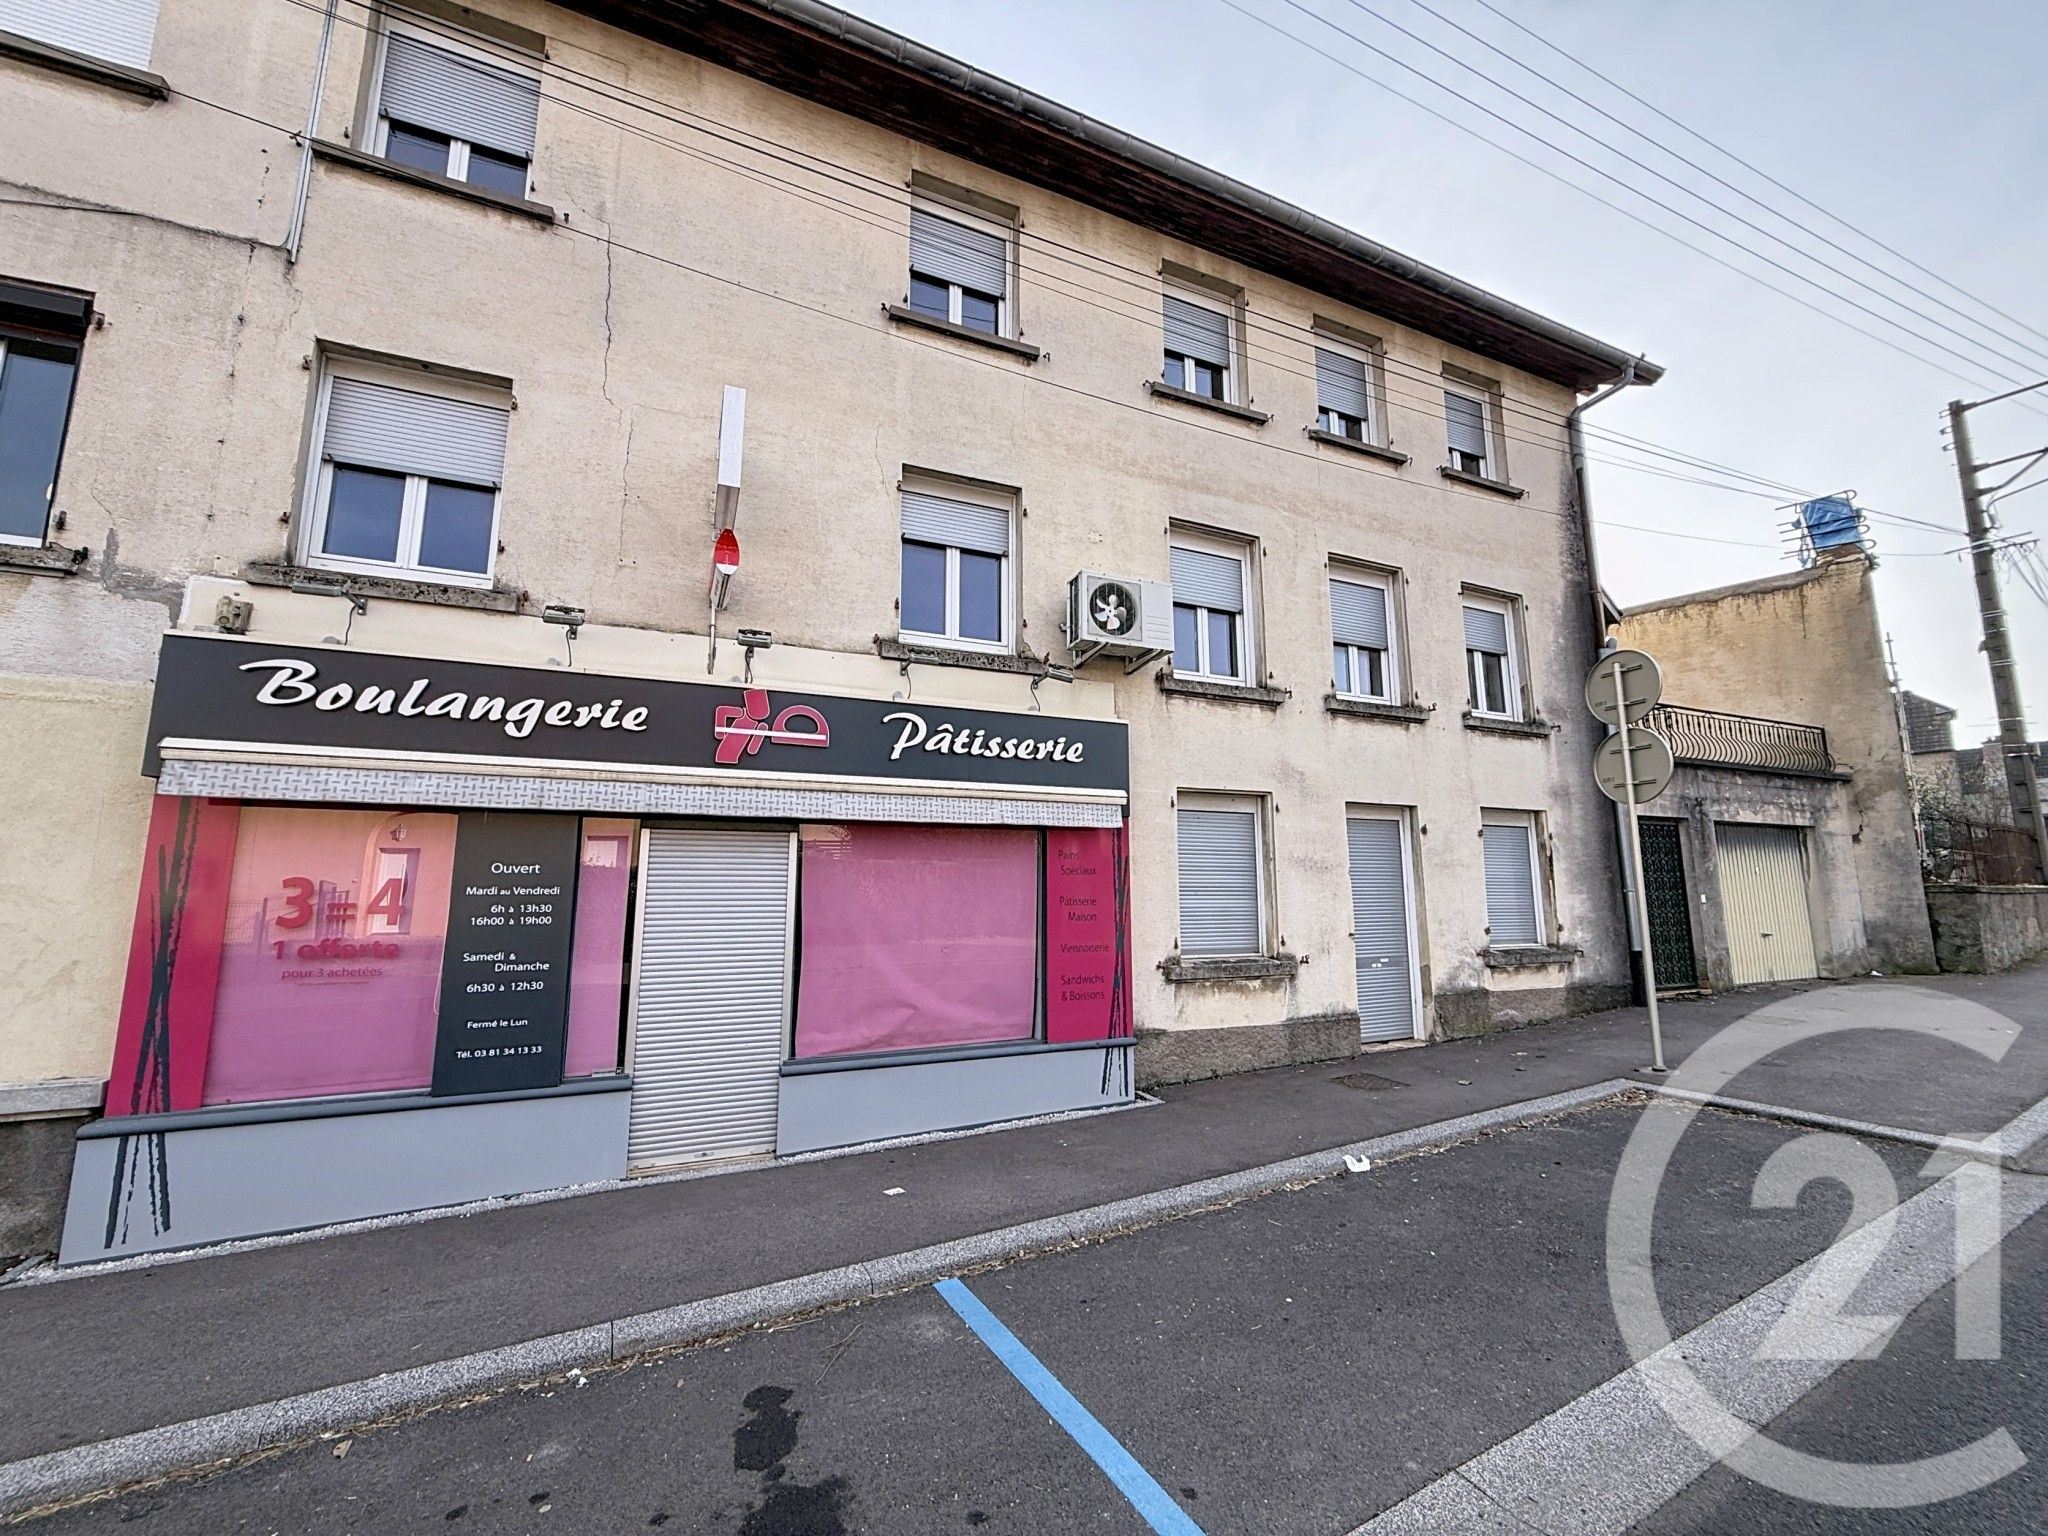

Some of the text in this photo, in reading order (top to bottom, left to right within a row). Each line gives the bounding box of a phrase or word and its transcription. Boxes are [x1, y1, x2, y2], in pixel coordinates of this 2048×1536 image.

[239, 658, 649, 738] Boulangerie
[883, 712, 1084, 763] Pâtisserie
[1058, 850, 1079, 860] Pains
[491, 862, 540, 874] Ouvert
[466, 886, 498, 895] Mardi
[513, 886, 560, 895] Vendredi
[490, 904, 505, 913] 6h
[520, 904, 552, 913] 13h30
[471, 916, 504, 926] 16h00
[520, 916, 552, 925] 19h00
[1068, 912, 1097, 921] Maison
[273, 937, 401, 961] 1 offerte
[1060, 943, 1109, 953] Viennoiserie
[463, 952, 504, 962] Samedi
[494, 962, 550, 972] Dimanche
[282, 966, 383, 980] pour 3 achetées
[1061, 974, 1104, 985] Sandwichs
[466, 983, 495, 993] 6h30
[511, 981, 544, 991] 12h30
[1061, 991, 1104, 1001] & Boissons
[467, 1020, 498, 1029] Fermé
[500, 1019, 508, 1027] le
[456, 1045, 542, 1059] Tél. 03 81 34 13 33
